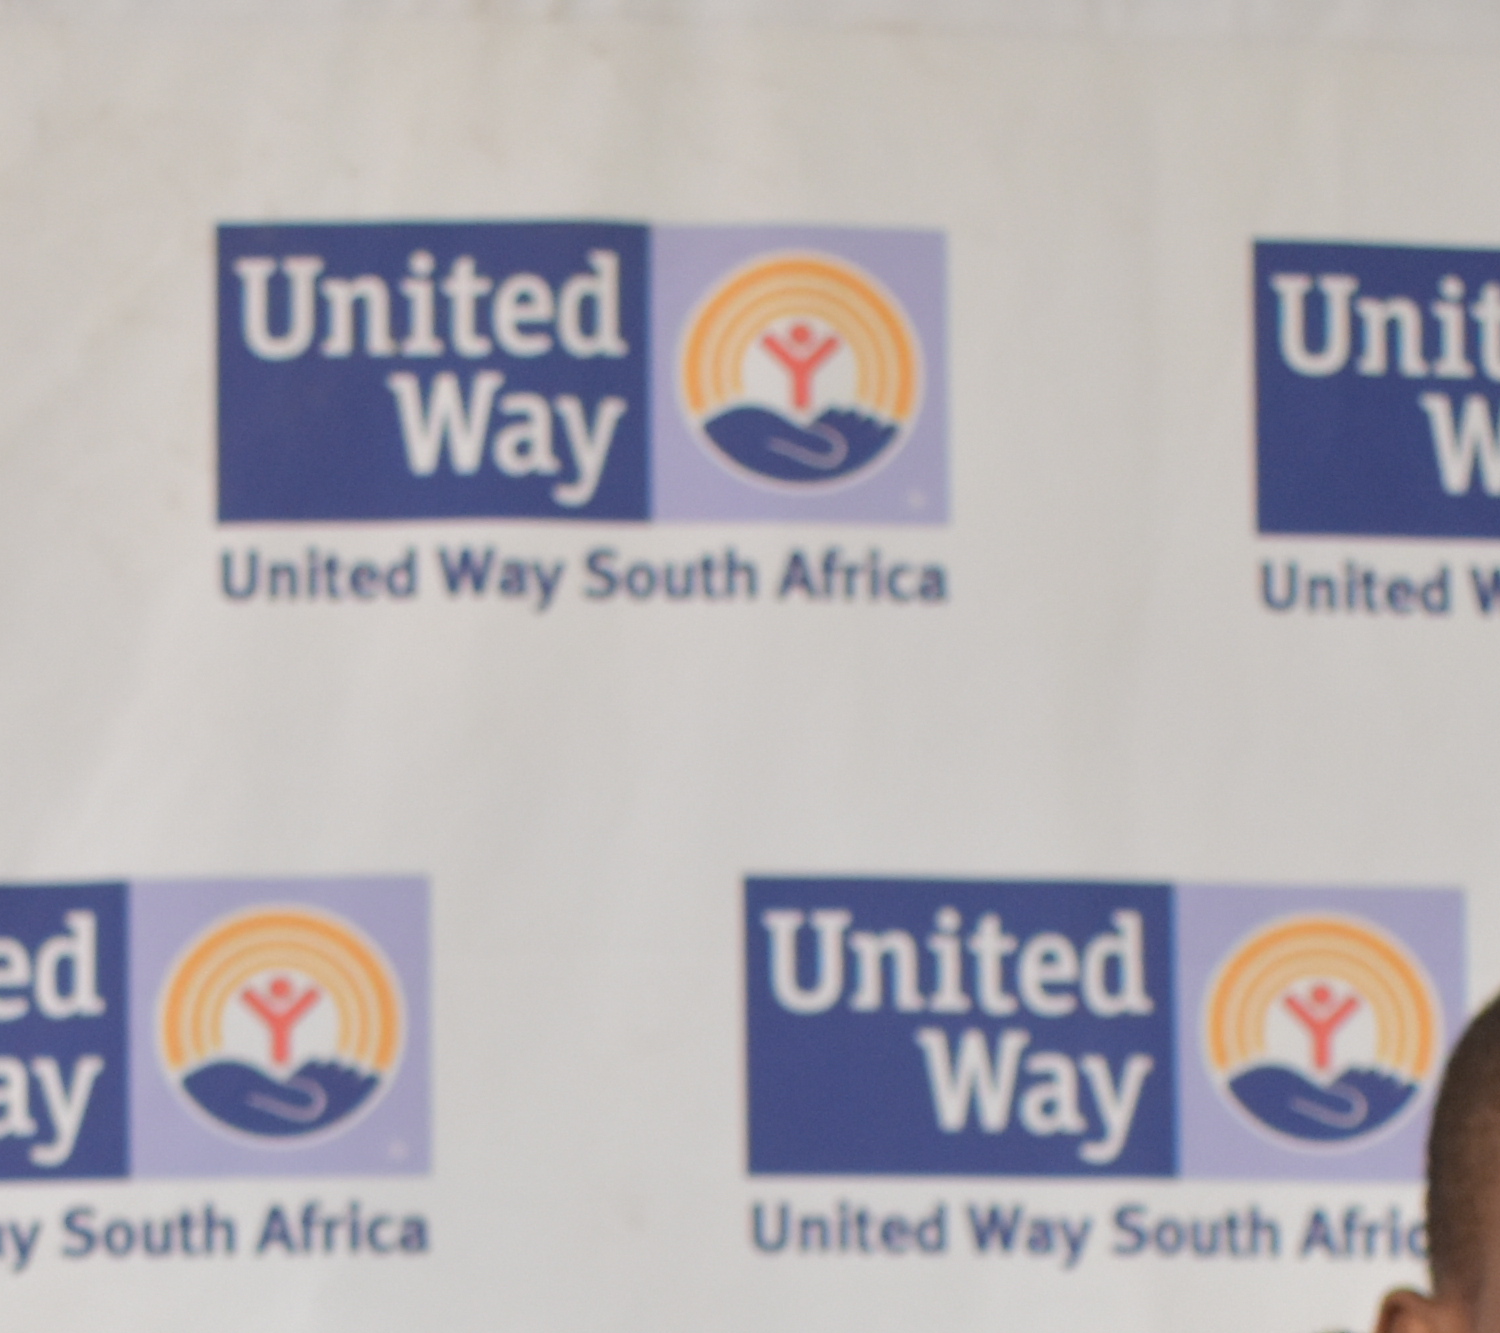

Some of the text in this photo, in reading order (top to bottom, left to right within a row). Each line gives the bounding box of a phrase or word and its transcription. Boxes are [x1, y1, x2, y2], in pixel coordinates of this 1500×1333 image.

[234, 252, 628, 360] United
[386, 372, 627, 506] Way
[217, 547, 948, 611] United Way South Africa
[1259, 558, 1452, 616] United
[763, 906, 1154, 1016] United
[917, 1027, 1152, 1165] Way
[61, 1203, 236, 1258] South
[255, 1200, 429, 1257] Africa
[751, 1200, 1429, 1271] United Way South Afric
